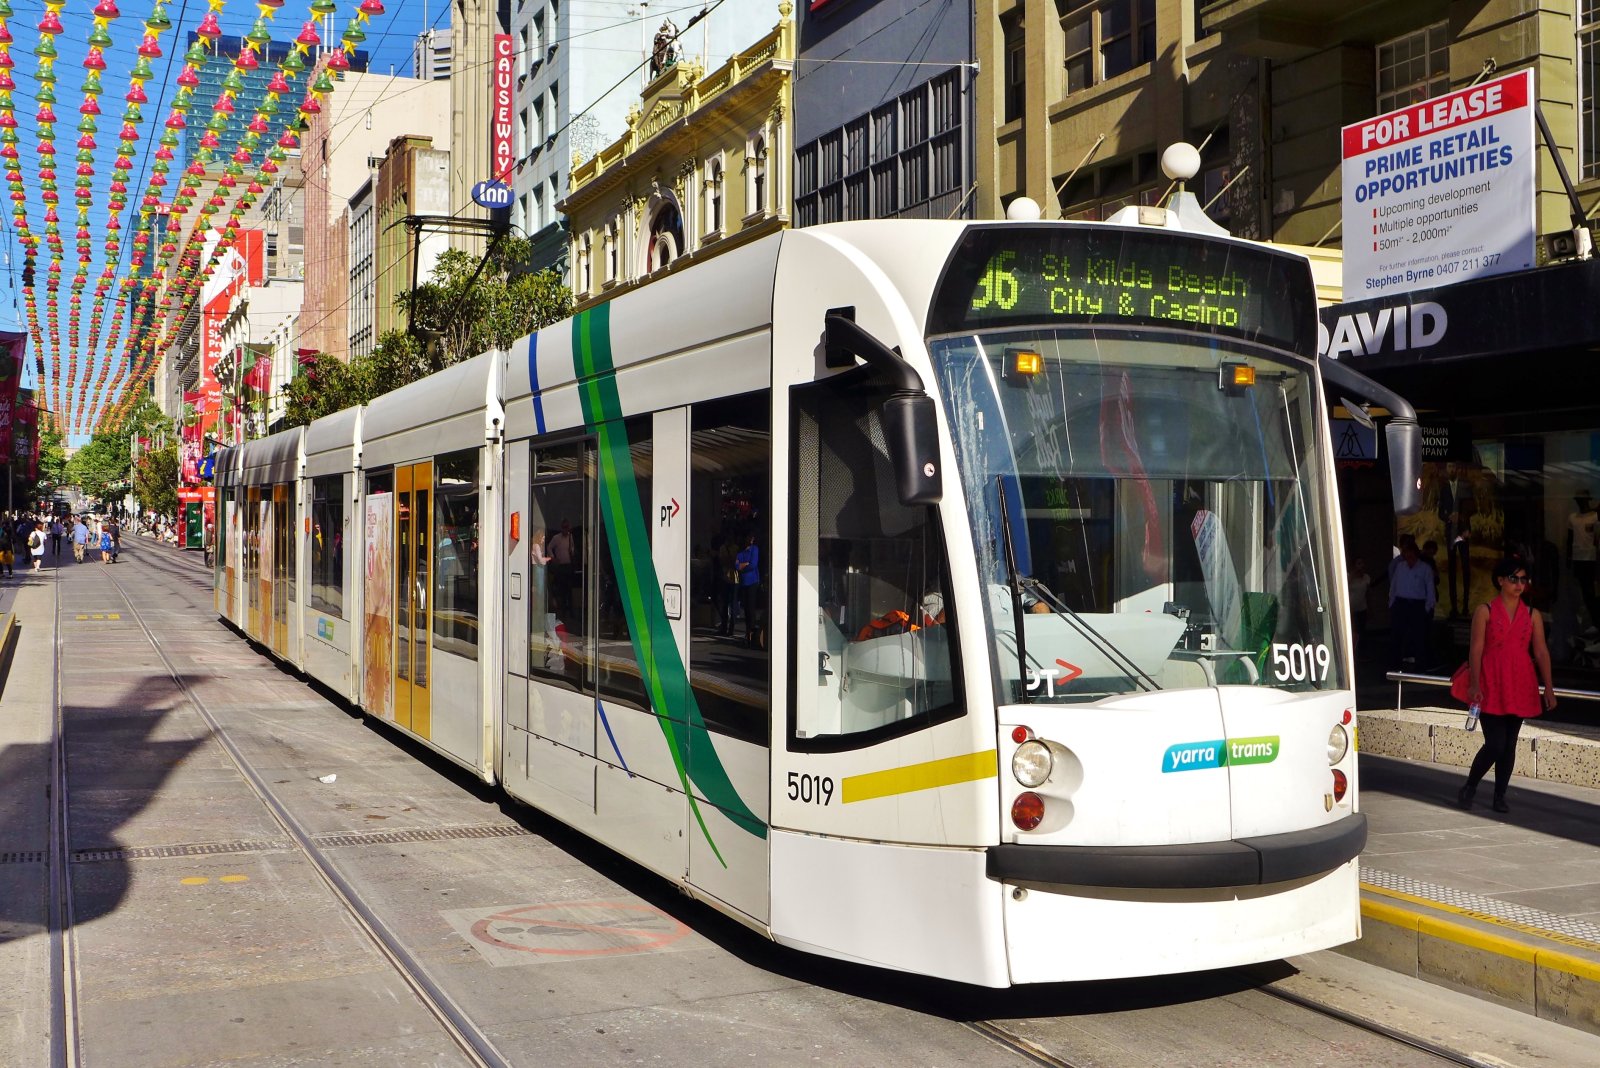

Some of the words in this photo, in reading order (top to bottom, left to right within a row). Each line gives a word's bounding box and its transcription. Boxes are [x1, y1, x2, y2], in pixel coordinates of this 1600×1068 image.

[497, 40, 511, 172] CAUSEWAY
[1362, 114, 1410, 150] FOR
[1418, 84, 1503, 133] LEASE
[1365, 145, 1423, 178] PRIME
[1430, 124, 1500, 161] RETAIL
[480, 183, 508, 203] Inn
[1355, 145, 1513, 203] OPPORTUNITIES
[1379, 197, 1425, 218] Upcoming
[1427, 180, 1491, 207] development
[1379, 217, 1414, 234] Multiple
[1416, 203, 1479, 227] opportunities
[1365, 274, 1404, 290] Stephen
[1406, 268, 1434, 284] Byrne
[1436, 261, 1460, 276] 0407
[1462, 258, 1479, 271] 211
[1482, 253, 1501, 268] 377
[1441, 250, 1460, 261] please
[1042, 254, 1071, 282] St
[1087, 257, 1154, 290] Kilda
[1168, 265, 1247, 297] Beach
[1050, 287, 1103, 315] City
[1119, 292, 1136, 316] &
[1150, 295, 1238, 327] Casino
[1319, 301, 1448, 360] AVID
[1273, 643, 1330, 682] 5019
[1171, 747, 1215, 768] yarra
[1231, 738, 1273, 758] trams
[787, 772, 834, 806] 5019
